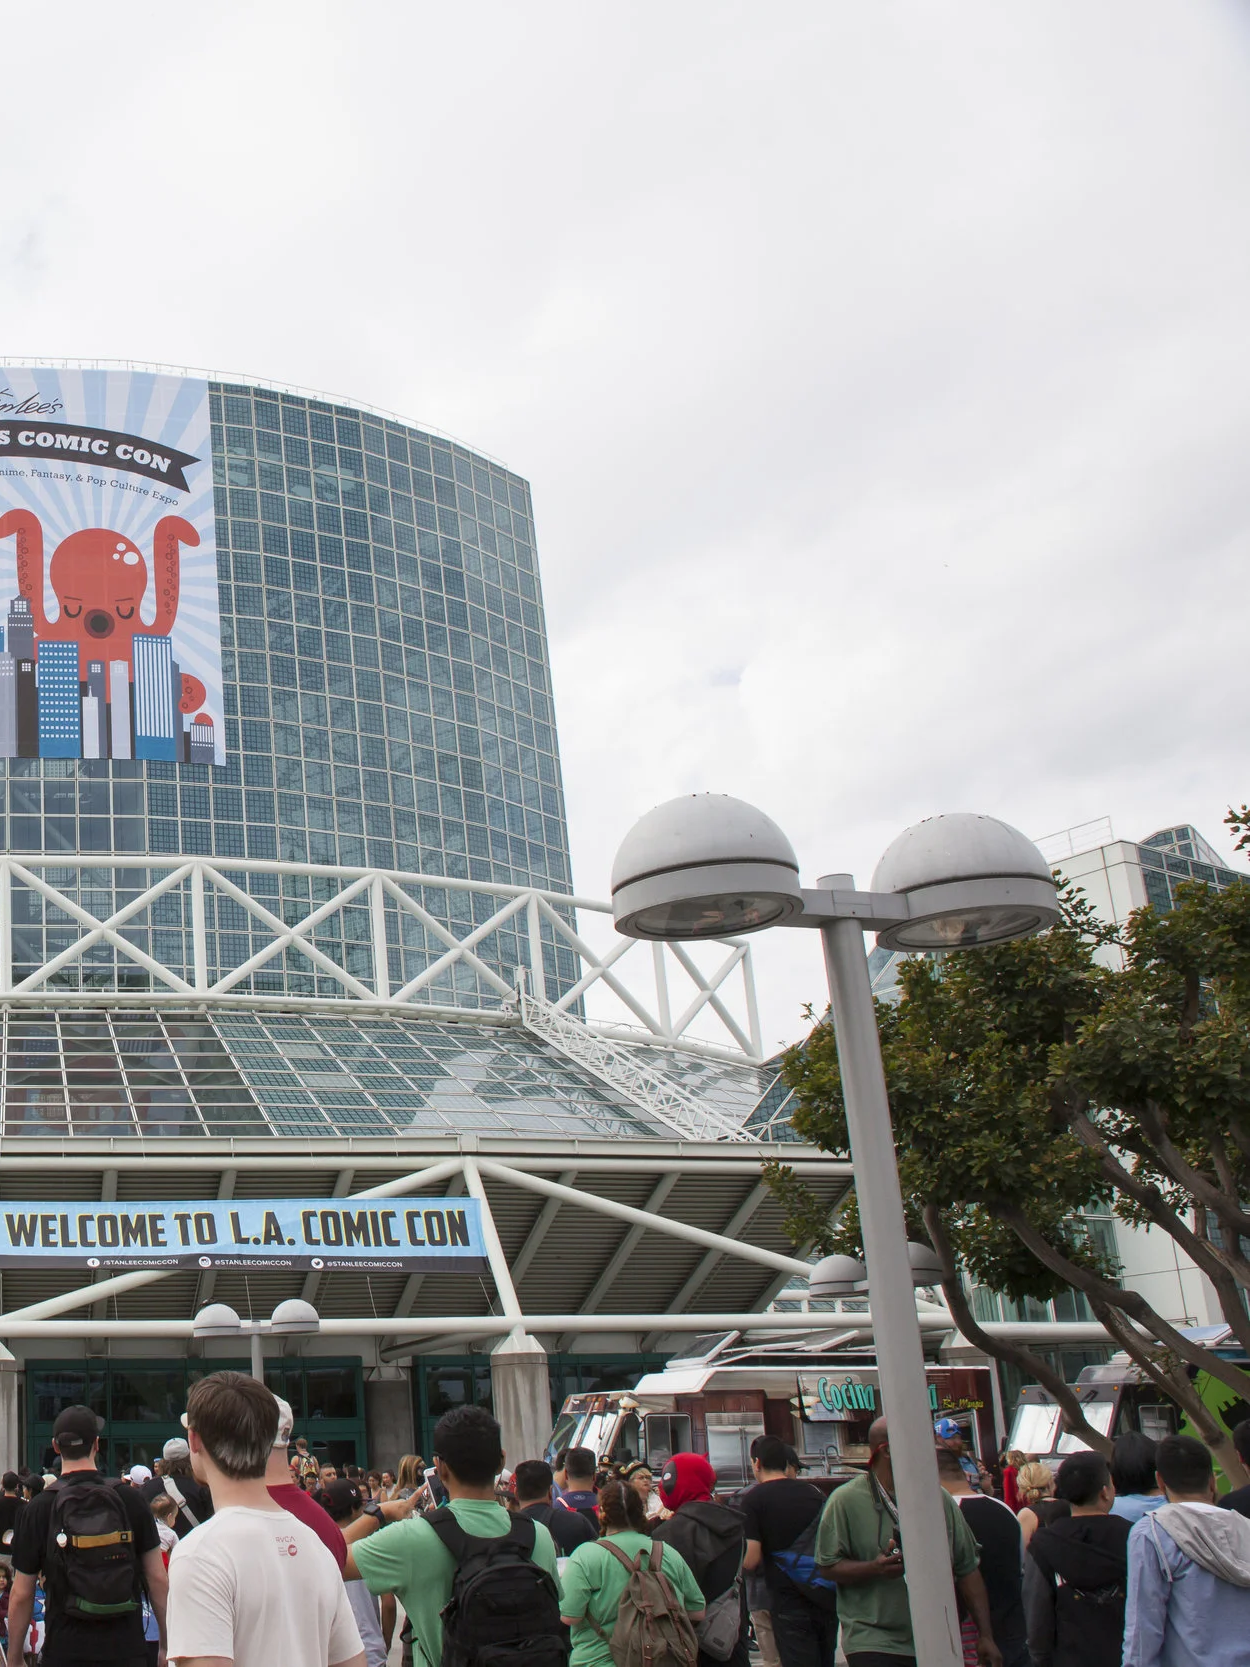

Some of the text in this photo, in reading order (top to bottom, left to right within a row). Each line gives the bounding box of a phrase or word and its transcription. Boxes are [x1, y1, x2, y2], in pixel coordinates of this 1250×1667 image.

[17, 430, 110, 455] COMIC
[115, 444, 172, 473] CON
[31, 470, 73, 482] Fantasy,
[75, 474, 84, 482] &
[87, 475, 107, 488] Pop
[110, 479, 149, 496] Culture
[152, 491, 179, 507] Expo
[4, 1209, 471, 1248] WELCOME TO L.A. COMIC CON
[214, 1258, 292, 1267] @STANLEECOMICCON
[327, 1259, 403, 1269] @STANLEECOMICCON
[817, 1376, 876, 1412] Cocina
